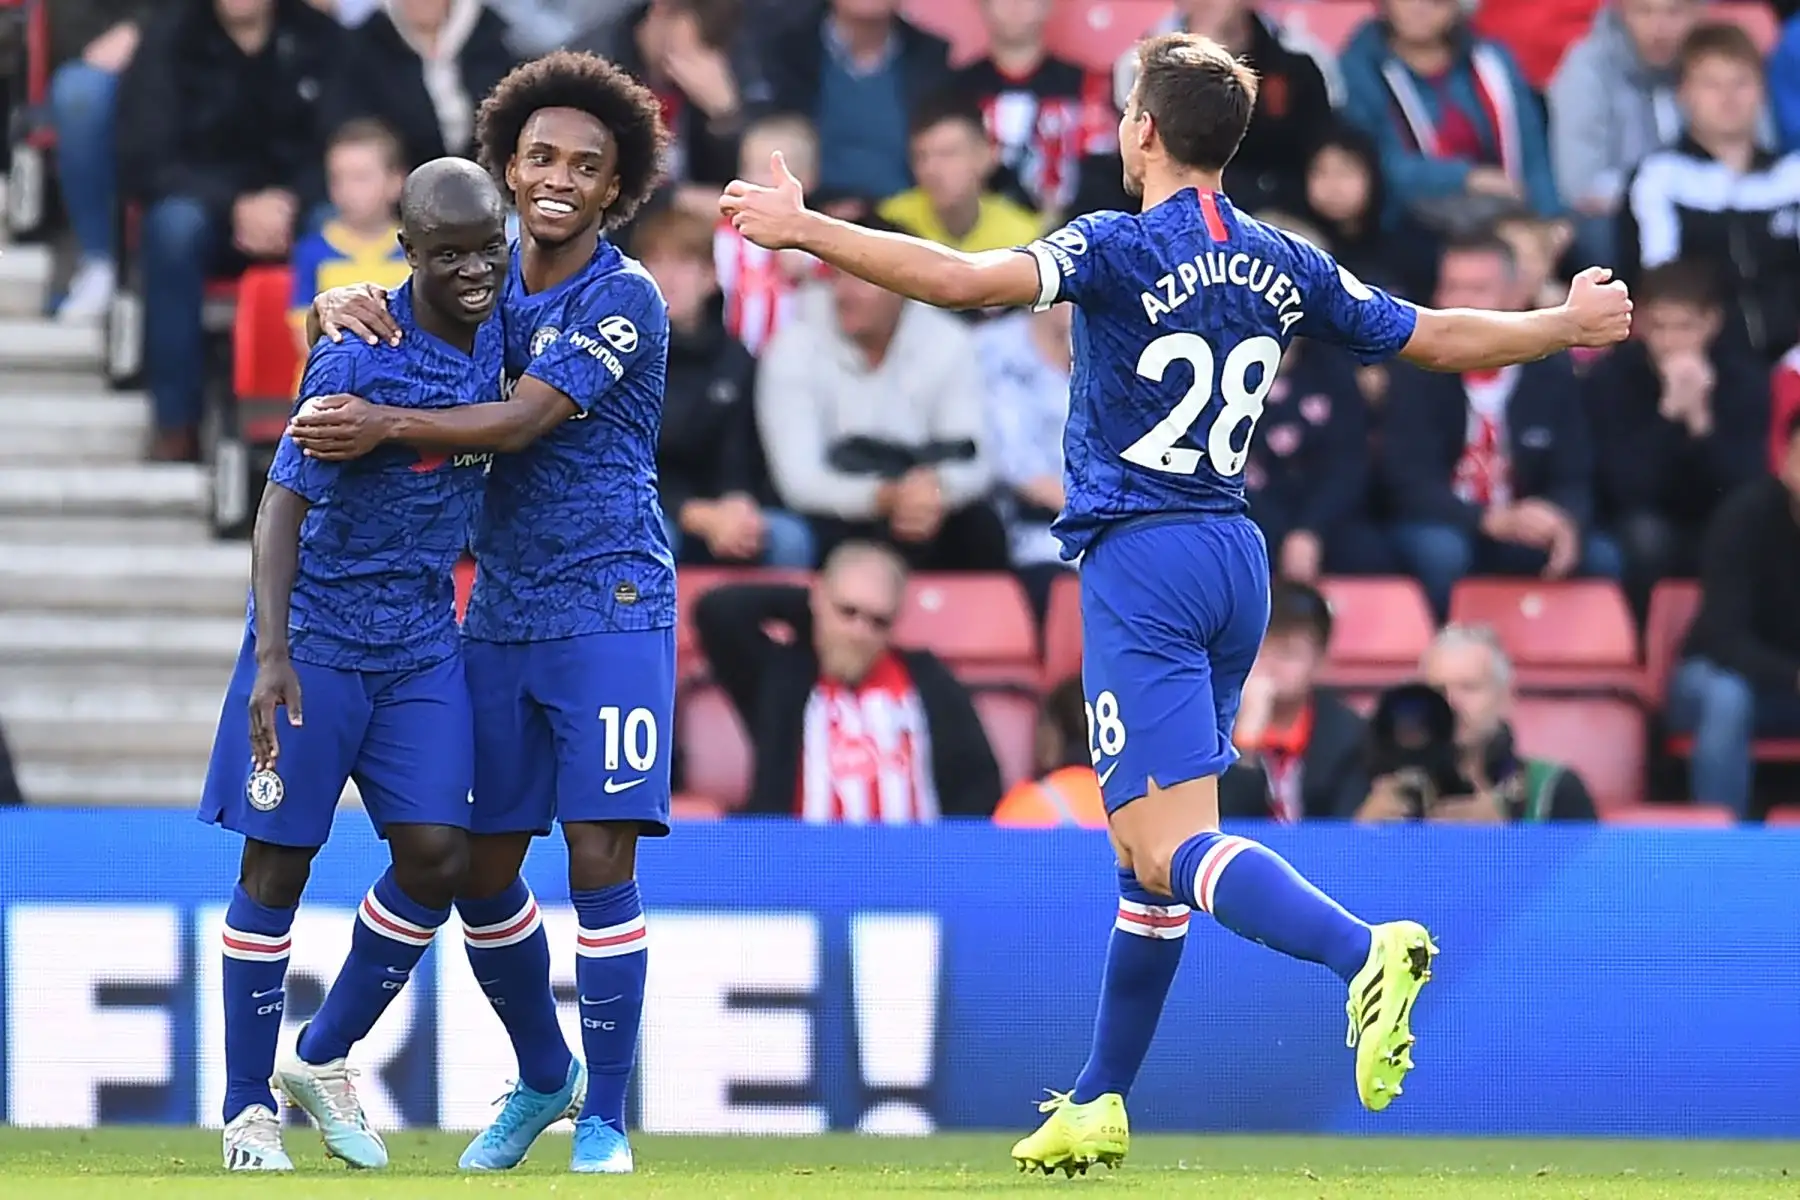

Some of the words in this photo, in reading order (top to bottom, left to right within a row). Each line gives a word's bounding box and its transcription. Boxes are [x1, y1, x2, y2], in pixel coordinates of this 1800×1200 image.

[1140, 252, 1304, 336] AZPILICUETA
[569, 331, 624, 381] HYUNDA
[1119, 332, 1281, 477] 28
[599, 706, 657, 771] 10
[583, 1017, 615, 1030] CFC
